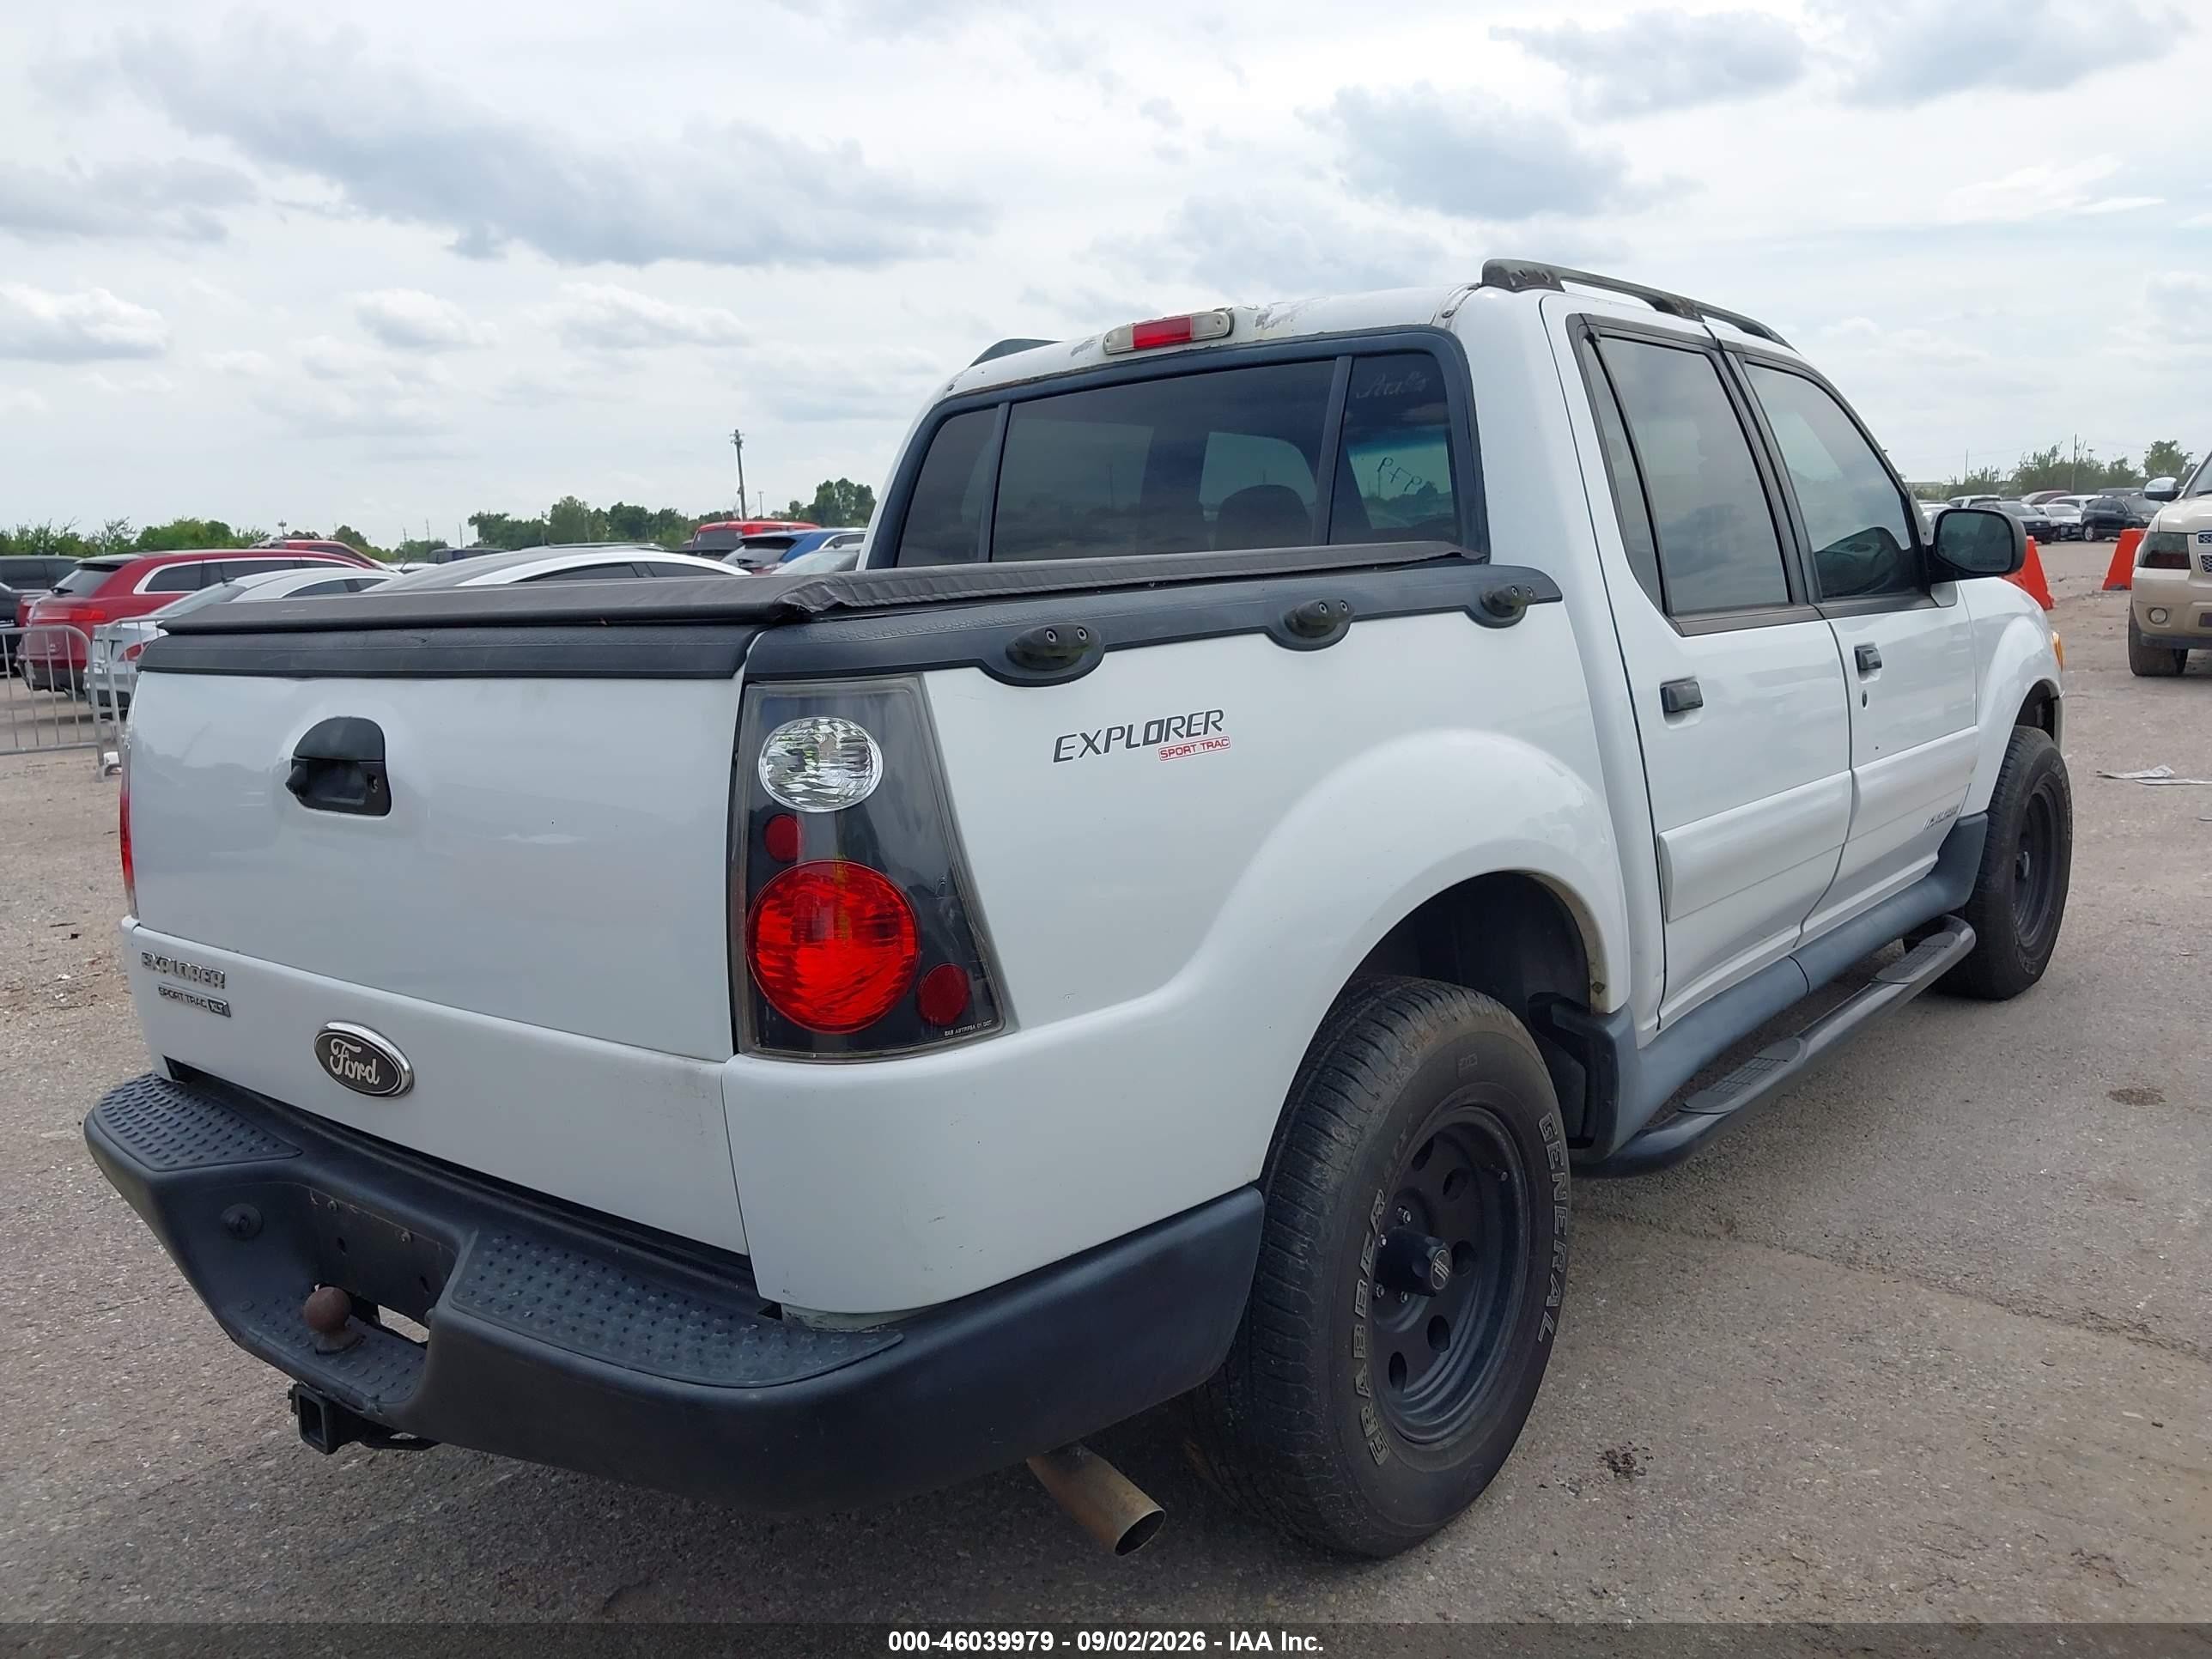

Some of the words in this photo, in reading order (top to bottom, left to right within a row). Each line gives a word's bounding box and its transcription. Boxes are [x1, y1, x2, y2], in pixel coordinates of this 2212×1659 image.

[1053, 708, 1224, 763] EXPLORER
[1160, 744, 1197, 760] SPORT
[1200, 738, 1230, 751] TRAC
[141, 951, 226, 989] EXPLORER
[158, 987, 184, 1002] SPORT
[185, 994, 207, 1009] TRAC
[329, 1037, 380, 1085] Ford
[1538, 1111, 1569, 1343] GENERAL
[1353, 1188, 1391, 1466] GRABBER
